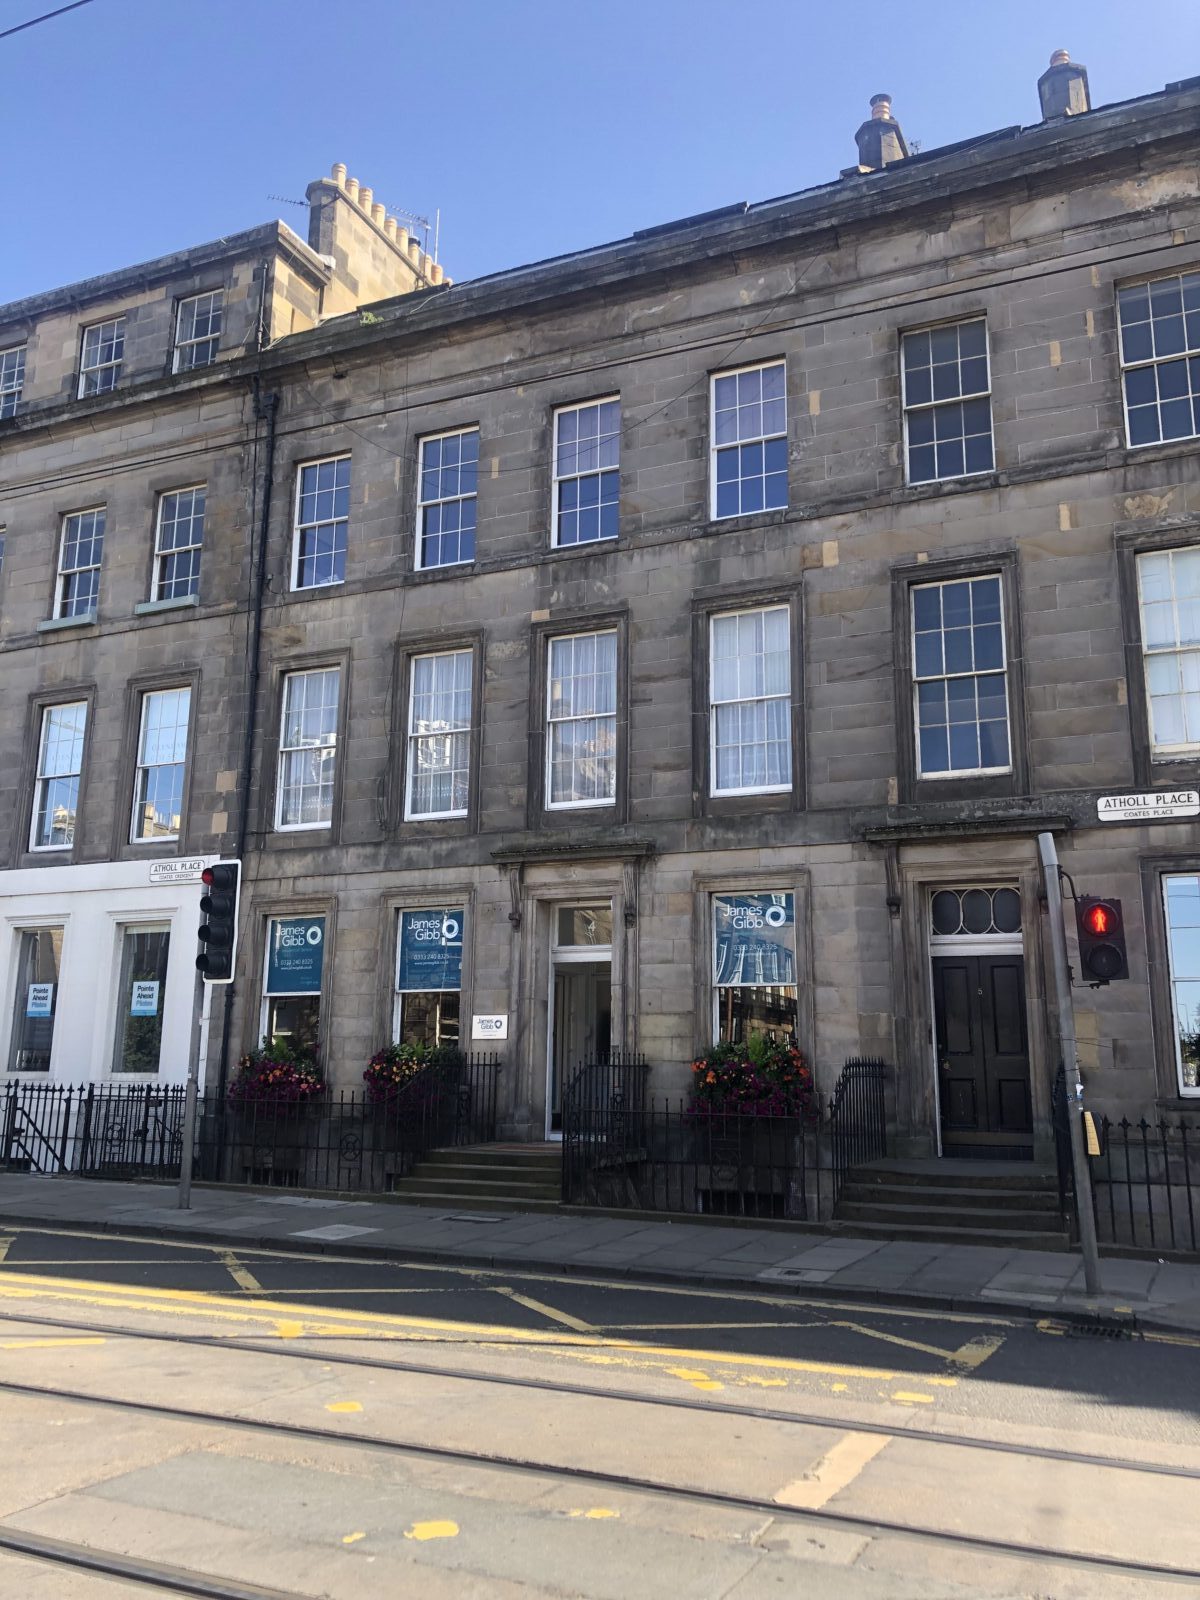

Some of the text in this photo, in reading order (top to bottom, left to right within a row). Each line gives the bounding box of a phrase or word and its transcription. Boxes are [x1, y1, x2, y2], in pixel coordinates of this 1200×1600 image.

[1104, 793, 1194, 808] ATHOLL PLACE
[1124, 808, 1174, 818] COATES PLACE
[153, 861, 201, 872] ATHOLL PLACE
[723, 904, 763, 917] James
[408, 918, 440, 930] James
[732, 915, 764, 929] Gibb
[415, 928, 440, 941] Gibb
[281, 935, 305, 947] Gibb
